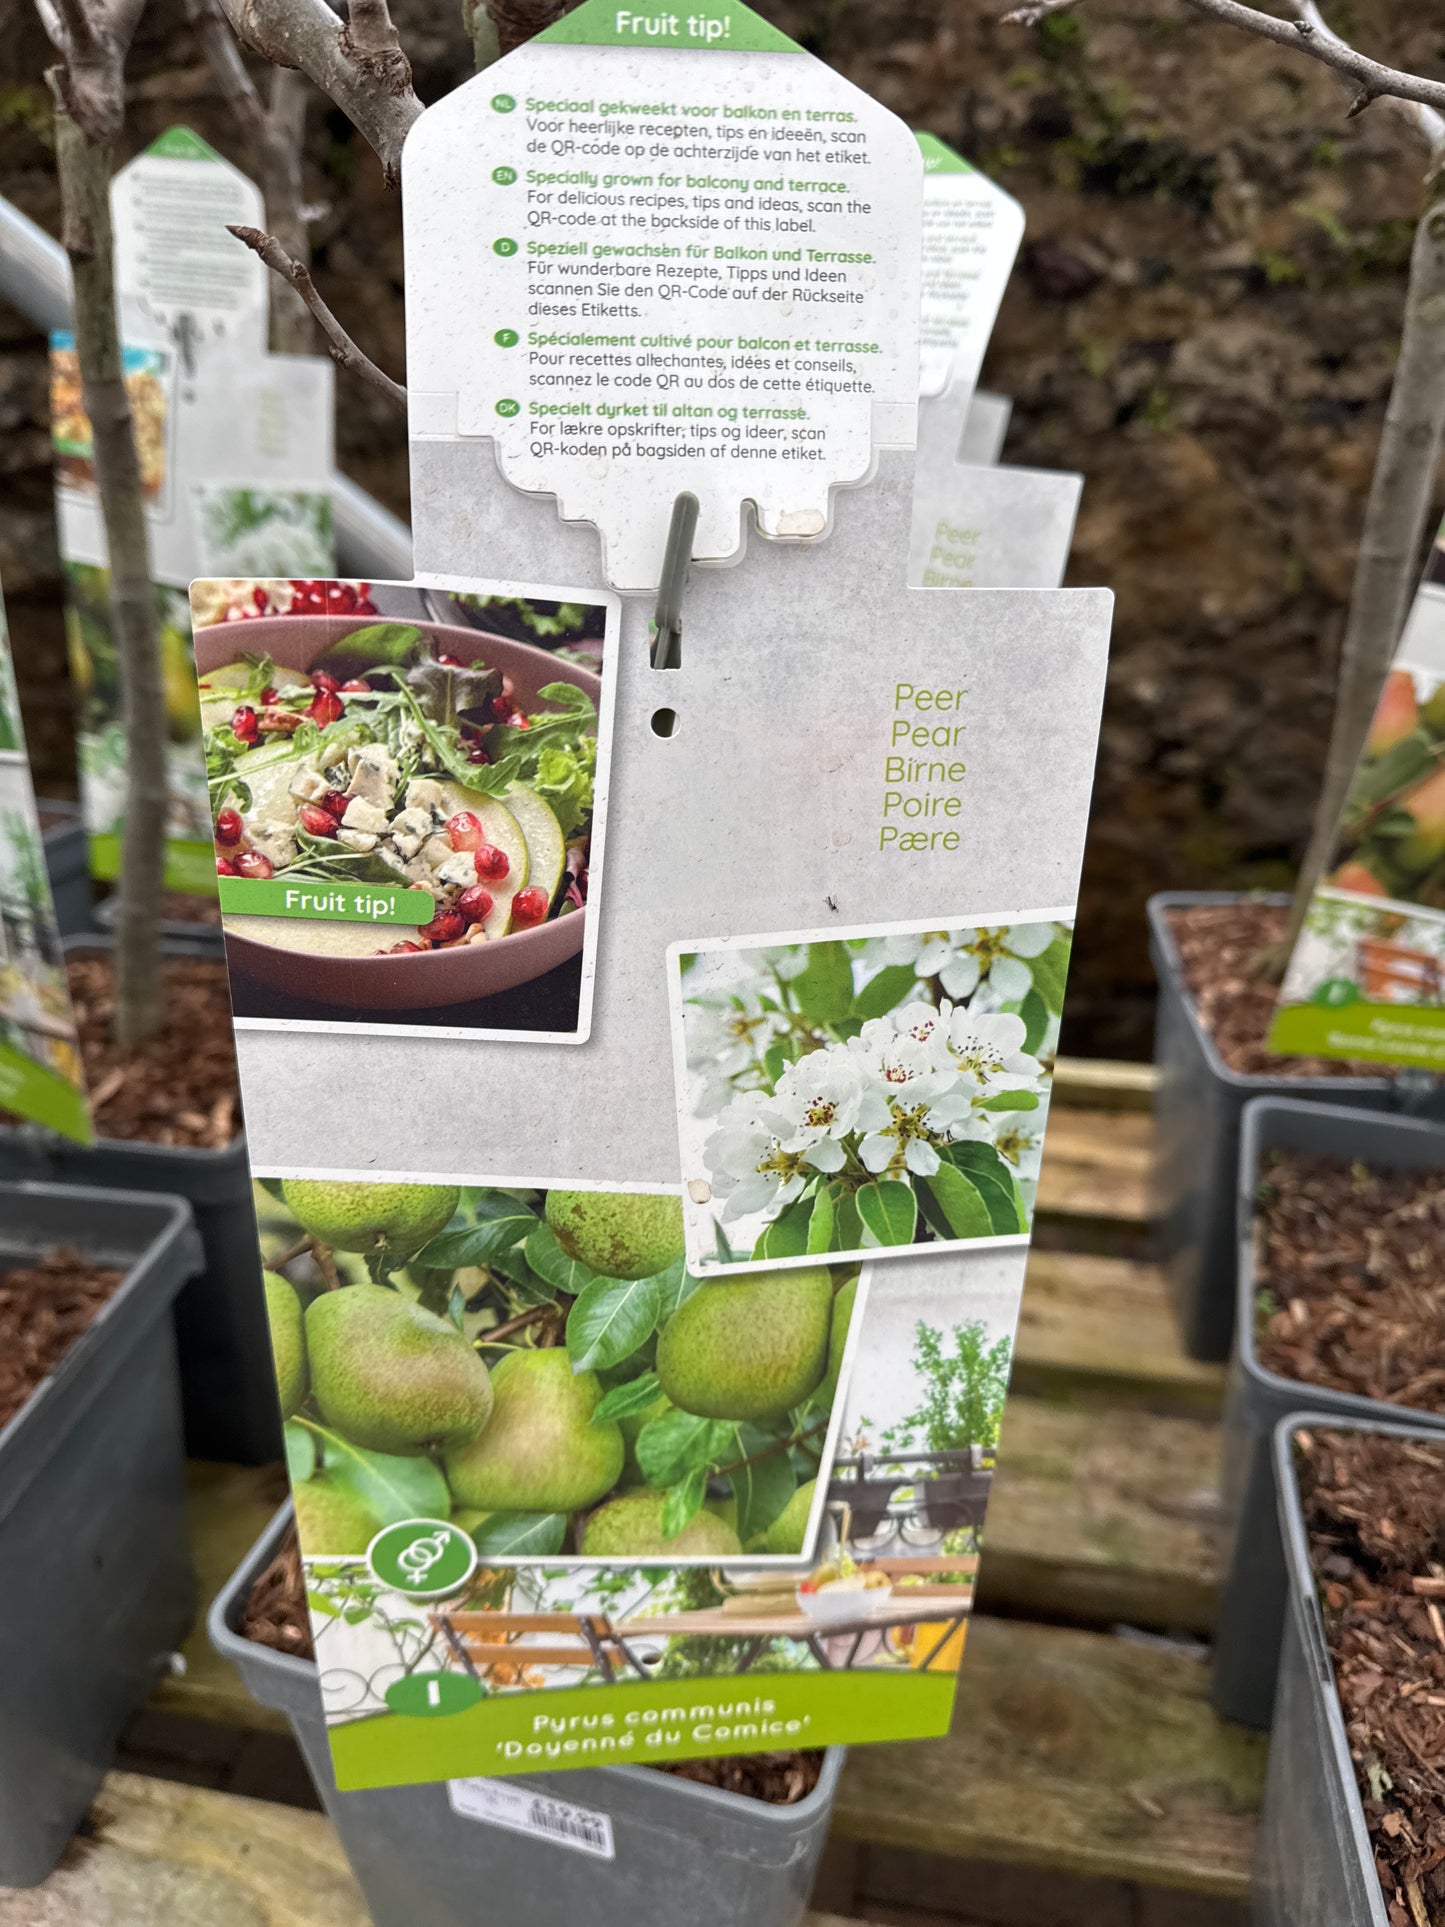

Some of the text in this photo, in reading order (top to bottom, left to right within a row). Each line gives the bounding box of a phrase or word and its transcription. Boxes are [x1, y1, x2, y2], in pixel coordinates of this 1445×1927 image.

[616, 10, 731, 43] Fruit tip!
[525, 98, 858, 122] Speciaal gekweekt voor balkon en terras.
[527, 119, 866, 144] Voor heerlijke recepten, tips en ideeën, scan
[527, 139, 871, 164] de QR-code op de achterzijde van het etiket.
[526, 170, 850, 194] Specially grown for balcony and terrace.
[527, 190, 871, 213] For delicious recipes, tips and ideas, scan the
[527, 211, 815, 233] QR-code at the backside of this label.
[527, 240, 876, 264] Speziell gewachsen für Balkon und Terrasse.
[527, 261, 847, 283] Für wunderbare Rezepte, Tipps und Ideen
[528, 283, 864, 303] scannen Sie den QR-Code auf der Rückseite
[528, 302, 642, 317] dieses Etiketts.
[527, 331, 883, 354] Spécialement cultivé pour balcon et terrasse.
[529, 352, 564, 365] Pour
[569, 354, 631, 366] recettes
[731, 356, 770, 369] idées
[775, 358, 789, 370] et
[794, 358, 856, 374] conseils,
[529, 373, 875, 394] scannez le code QR au dos de cette étiquette.
[528, 401, 810, 421] Specielt dyrket til altan og terrasse.
[530, 421, 825, 441] For lækre opskrifter, tips og ideer, scan
[530, 442, 826, 460] QR-koden på bagsiden af denne etiket.
[895, 683, 969, 711] Peer
[892, 720, 967, 747] Pear
[885, 756, 966, 783] Birne
[883, 791, 962, 818] Poire
[880, 826, 960, 851] Pære
[285, 890, 396, 919] Fruit tip!
[533, 1696, 776, 1734] Pyrus communis
[645, 1727, 681, 1747] du
